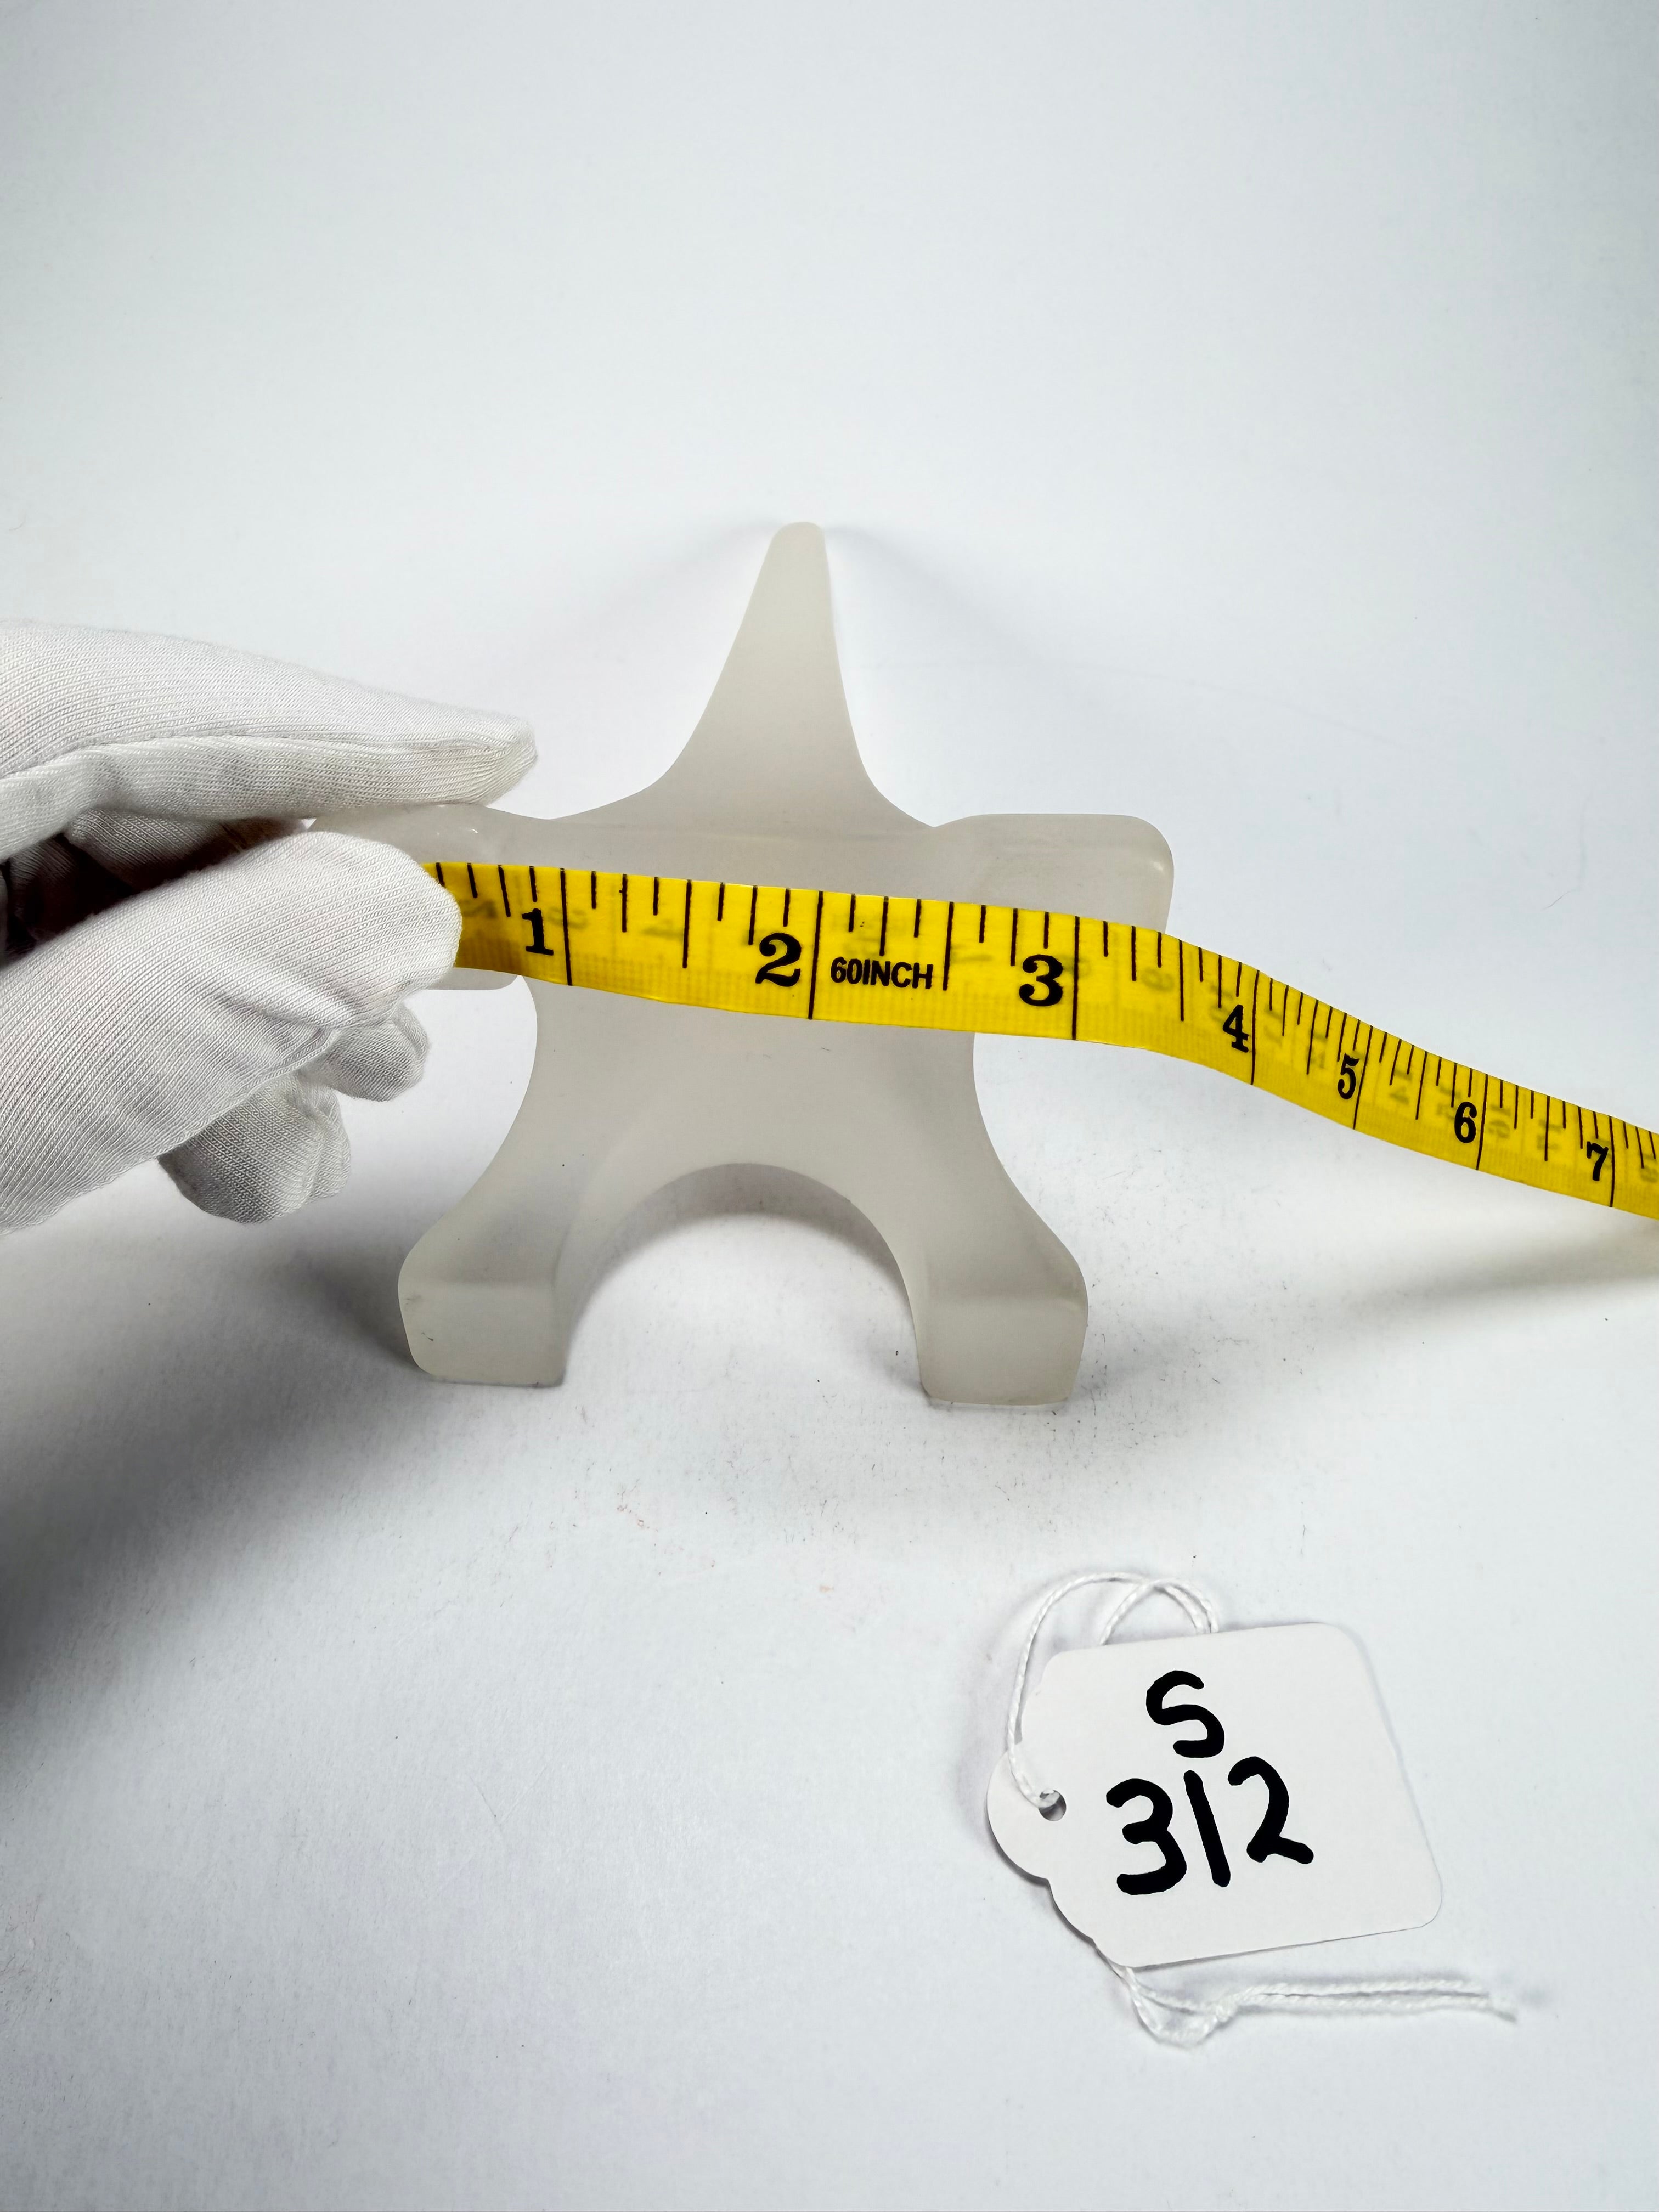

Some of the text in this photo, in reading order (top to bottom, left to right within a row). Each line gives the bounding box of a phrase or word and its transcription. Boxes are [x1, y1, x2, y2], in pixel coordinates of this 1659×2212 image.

[521, 908, 554, 956] 1
[755, 933, 802, 988] 2
[831, 957, 933, 990] 60INCH
[1019, 954, 1064, 1007] 3
[1222, 1004, 1249, 1053] 4
[1338, 1053, 1360, 1099] 5
[1454, 1101, 1477, 1143] 6
[1586, 1141, 1609, 1182] 7
[1146, 1670, 1225, 1758] S
[1105, 1756, 1314, 1895] 312
